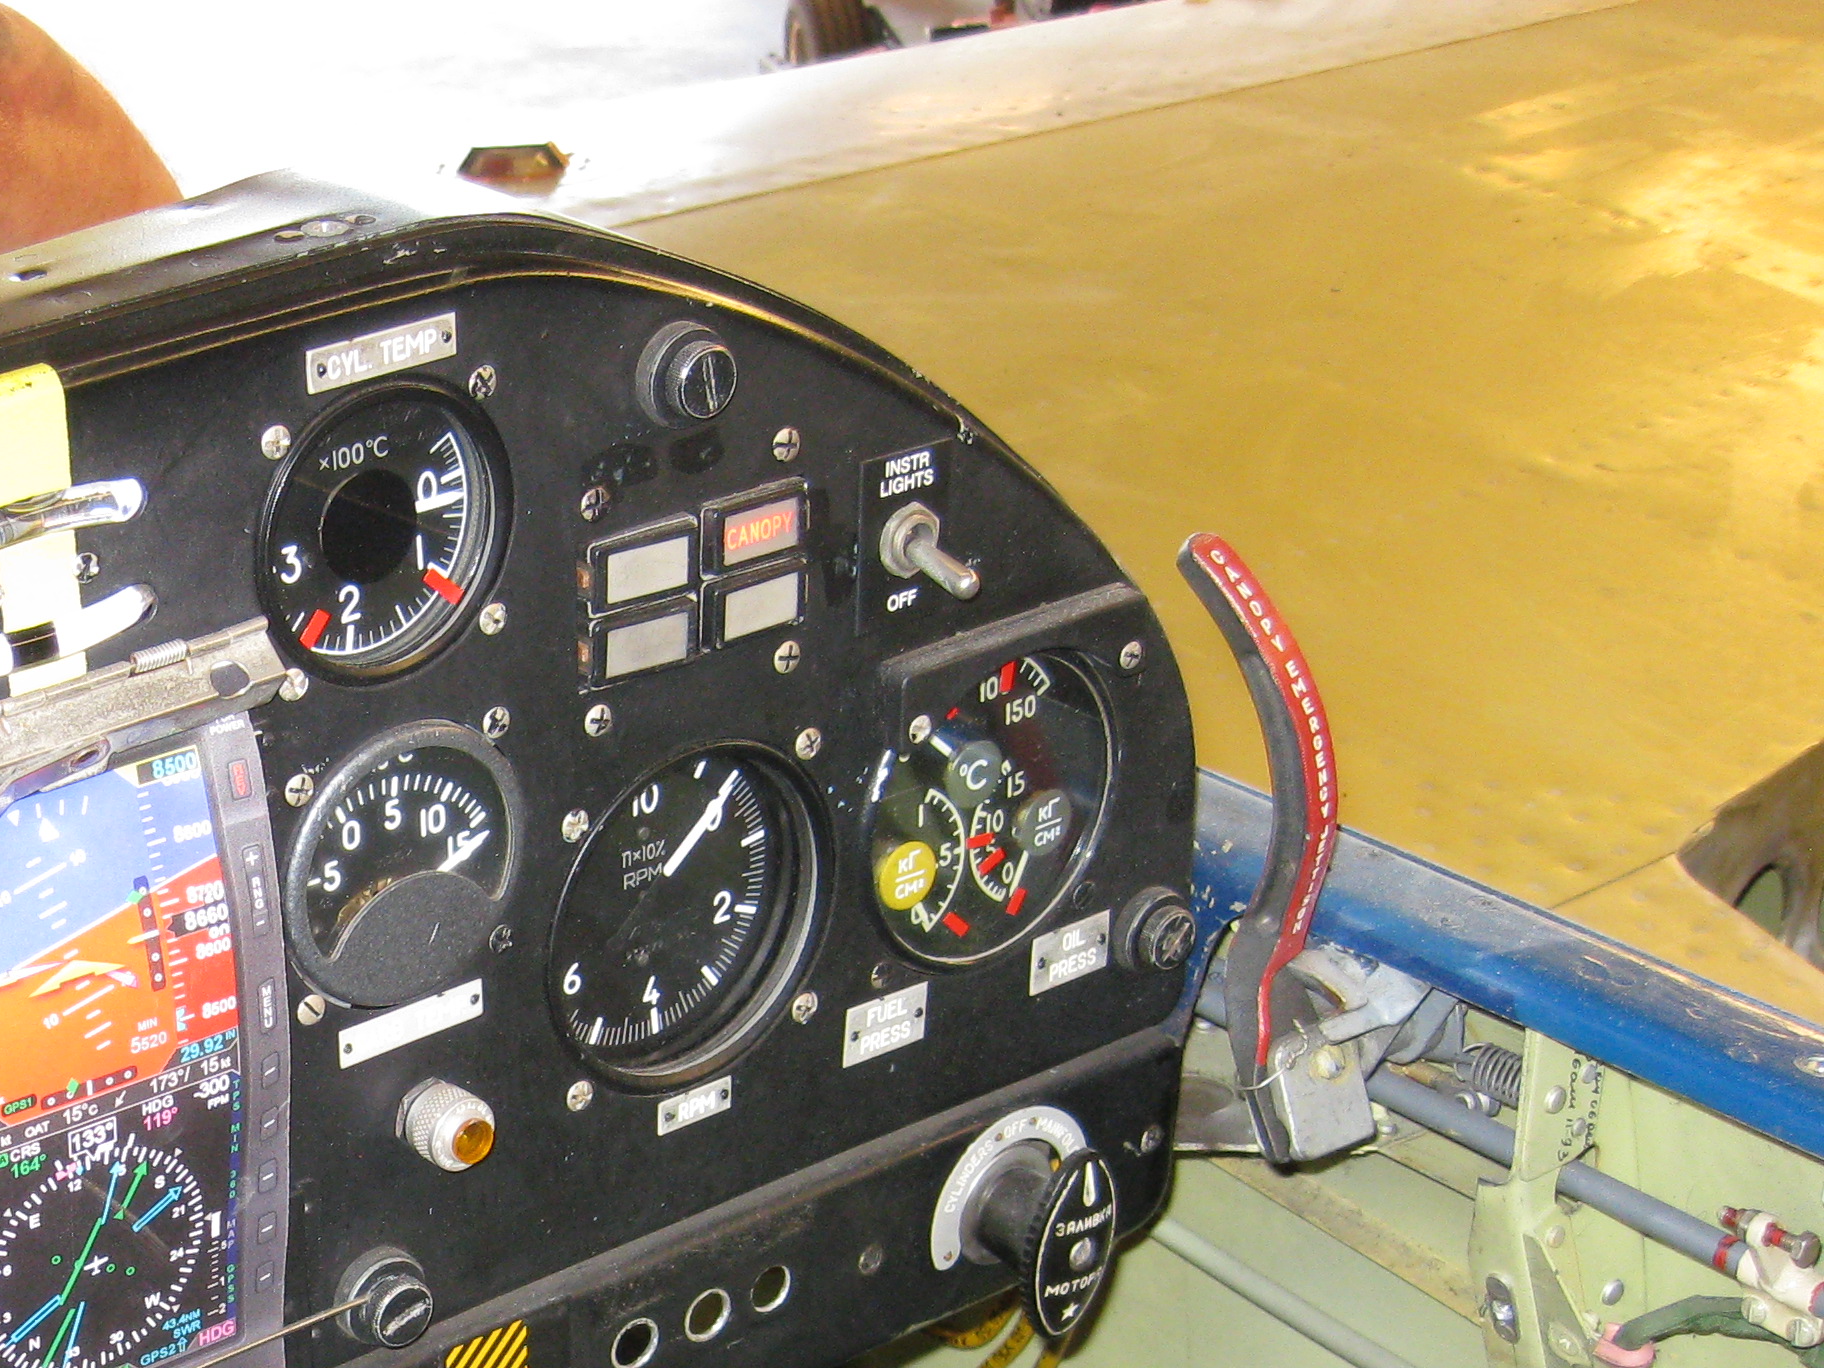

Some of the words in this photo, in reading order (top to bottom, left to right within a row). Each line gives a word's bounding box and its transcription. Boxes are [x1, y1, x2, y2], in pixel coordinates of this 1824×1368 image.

[326, 351, 373, 379] CYL.
[379, 328, 438, 363] TEMP
[884, 451, 930, 479] INSTR
[880, 469, 934, 498] LIGHTS
[726, 512, 794, 550] CANOPY
[280, 545, 302, 584] 3
[338, 585, 361, 624] 2
[887, 588, 917, 613] OFF
[1210, 549, 1284, 652] CANOPY
[1005, 695, 1036, 724] 150
[209, 719, 245, 735] POWER
[1284, 660, 1330, 819] EMERGENCY
[152, 751, 196, 779] 8500
[1007, 771, 1024, 798] 15
[633, 784, 659, 816] 10
[384, 802, 401, 831] 5
[421, 803, 445, 837] 10
[986, 809, 1004, 835] 10
[342, 820, 361, 851] 0
[623, 864, 663, 890] RPM
[1292, 824, 1328, 935] JETTISON
[252, 877, 264, 909] RNG
[713, 890, 731, 924] 2
[184, 903, 228, 931] 8660
[1062, 931, 1085, 952] OIL
[563, 963, 581, 995] 6
[1048, 947, 1097, 983] PRESS
[643, 976, 660, 1005] 4
[262, 985, 273, 1027] MENU
[867, 1000, 908, 1027] FUEL
[138, 1018, 158, 1032] MIN
[860, 1022, 911, 1056] PRESS
[131, 1032, 167, 1053] 5520
[180, 1034, 223, 1063] 29.92
[201, 1060, 219, 1075] 15
[3, 1097, 33, 1115] GPS1
[142, 1095, 174, 1116] HDG
[207, 1094, 229, 1110] FPM
[678, 1091, 717, 1122] RPM
[25, 1120, 50, 1138] OAT
[1004, 1119, 1028, 1139] OFF
[9, 1142, 41, 1161] CRS
[155, 1175, 166, 1189] S
[944, 1140, 994, 1213] CYLINDERS
[29, 1213, 41, 1229] E
[172, 1205, 186, 1219] 21
[1056, 1204, 1112, 1238] ЗАЛИВКА
[169, 1247, 184, 1262] 24
[145, 1292, 161, 1309] W
[109, 1331, 125, 1344] 30
[173, 1320, 201, 1339] SWR
[199, 1320, 235, 1346] HDG
[29, 1337, 41, 1351] N
[140, 1344, 175, 1366] GPS2
